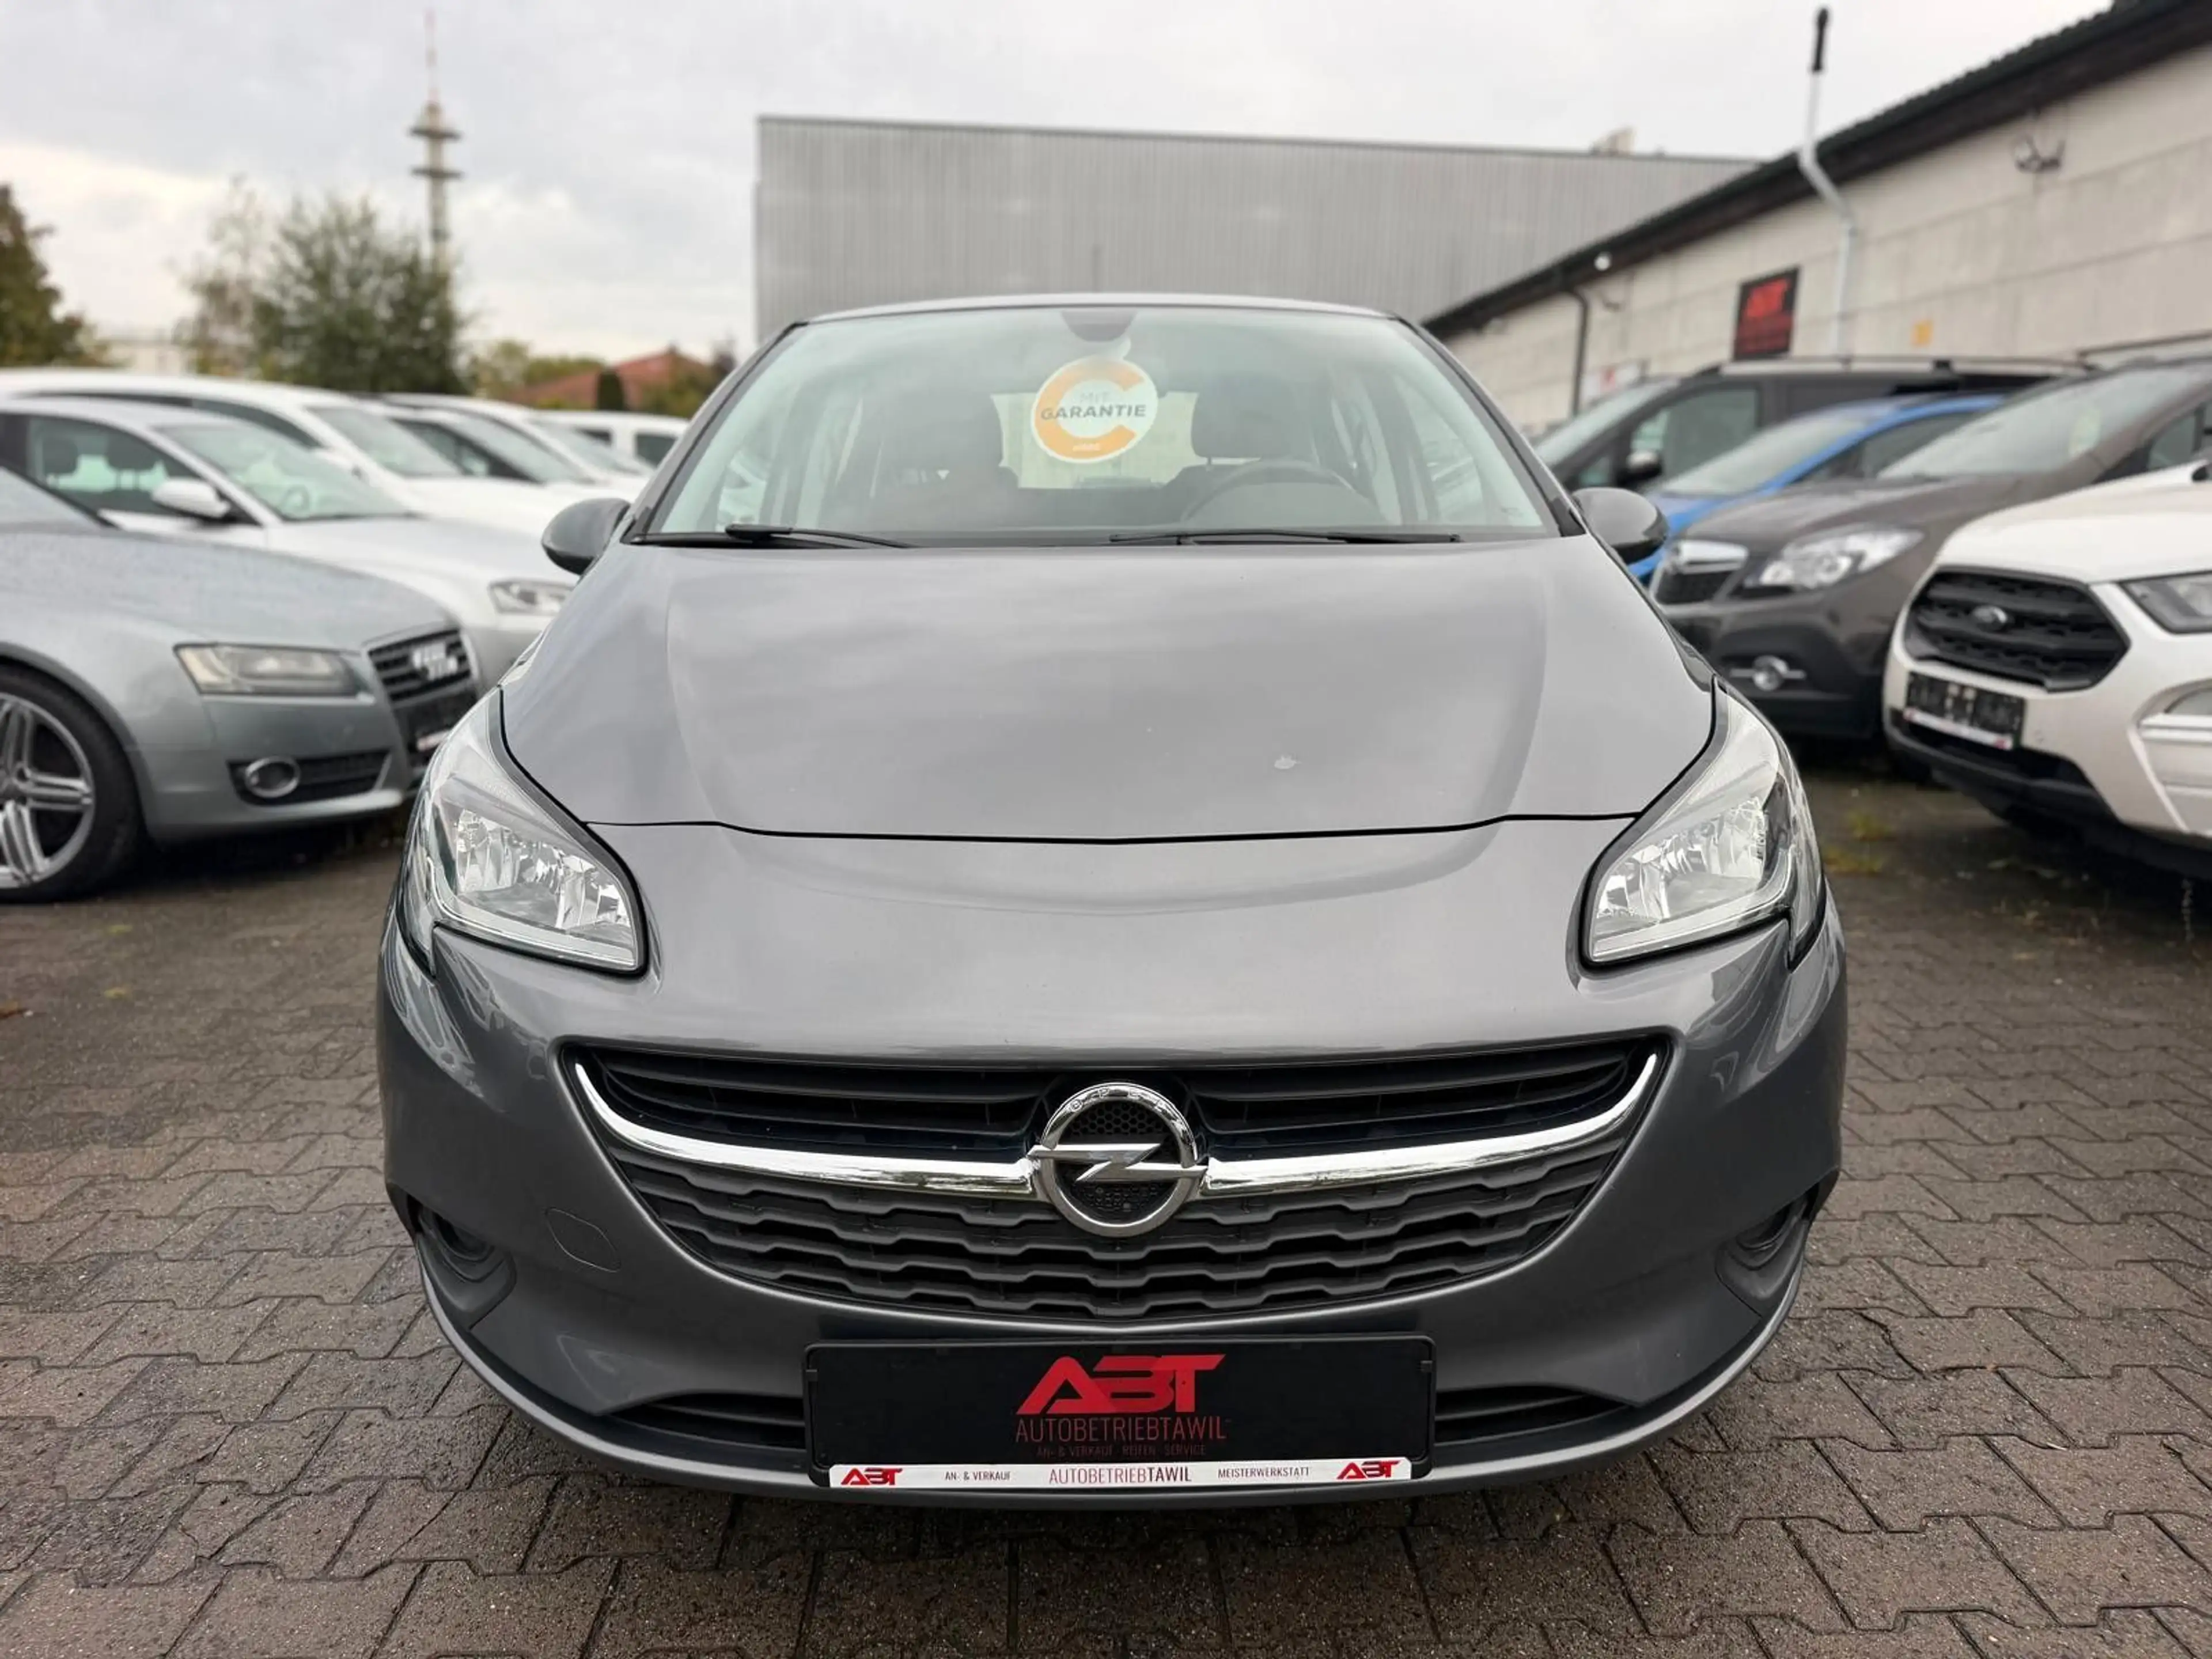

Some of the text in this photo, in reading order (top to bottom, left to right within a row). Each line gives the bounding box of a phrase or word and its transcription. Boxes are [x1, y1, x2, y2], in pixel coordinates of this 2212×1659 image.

[1040, 404, 1146, 421] GARANTIE
[1069, 1086, 1168, 1112] OPEL
[1015, 1354, 1226, 1415] ABT
[1015, 1416, 1227, 1443] AUTOBETRIEBTAWIL
[1069, 1445, 1113, 1457] VERKAUF
[1165, 1444, 1206, 1456] SERVICE
[840, 1467, 903, 1486] ABT
[964, 1471, 970, 1481] &
[974, 1471, 1012, 1481] VERKAUF
[1049, 1467, 1192, 1484] AUTOBETRIEBTAWIL
[1218, 1467, 1309, 1479] MEISTERWERKSTATT
[1336, 1461, 1401, 1479] ABT
